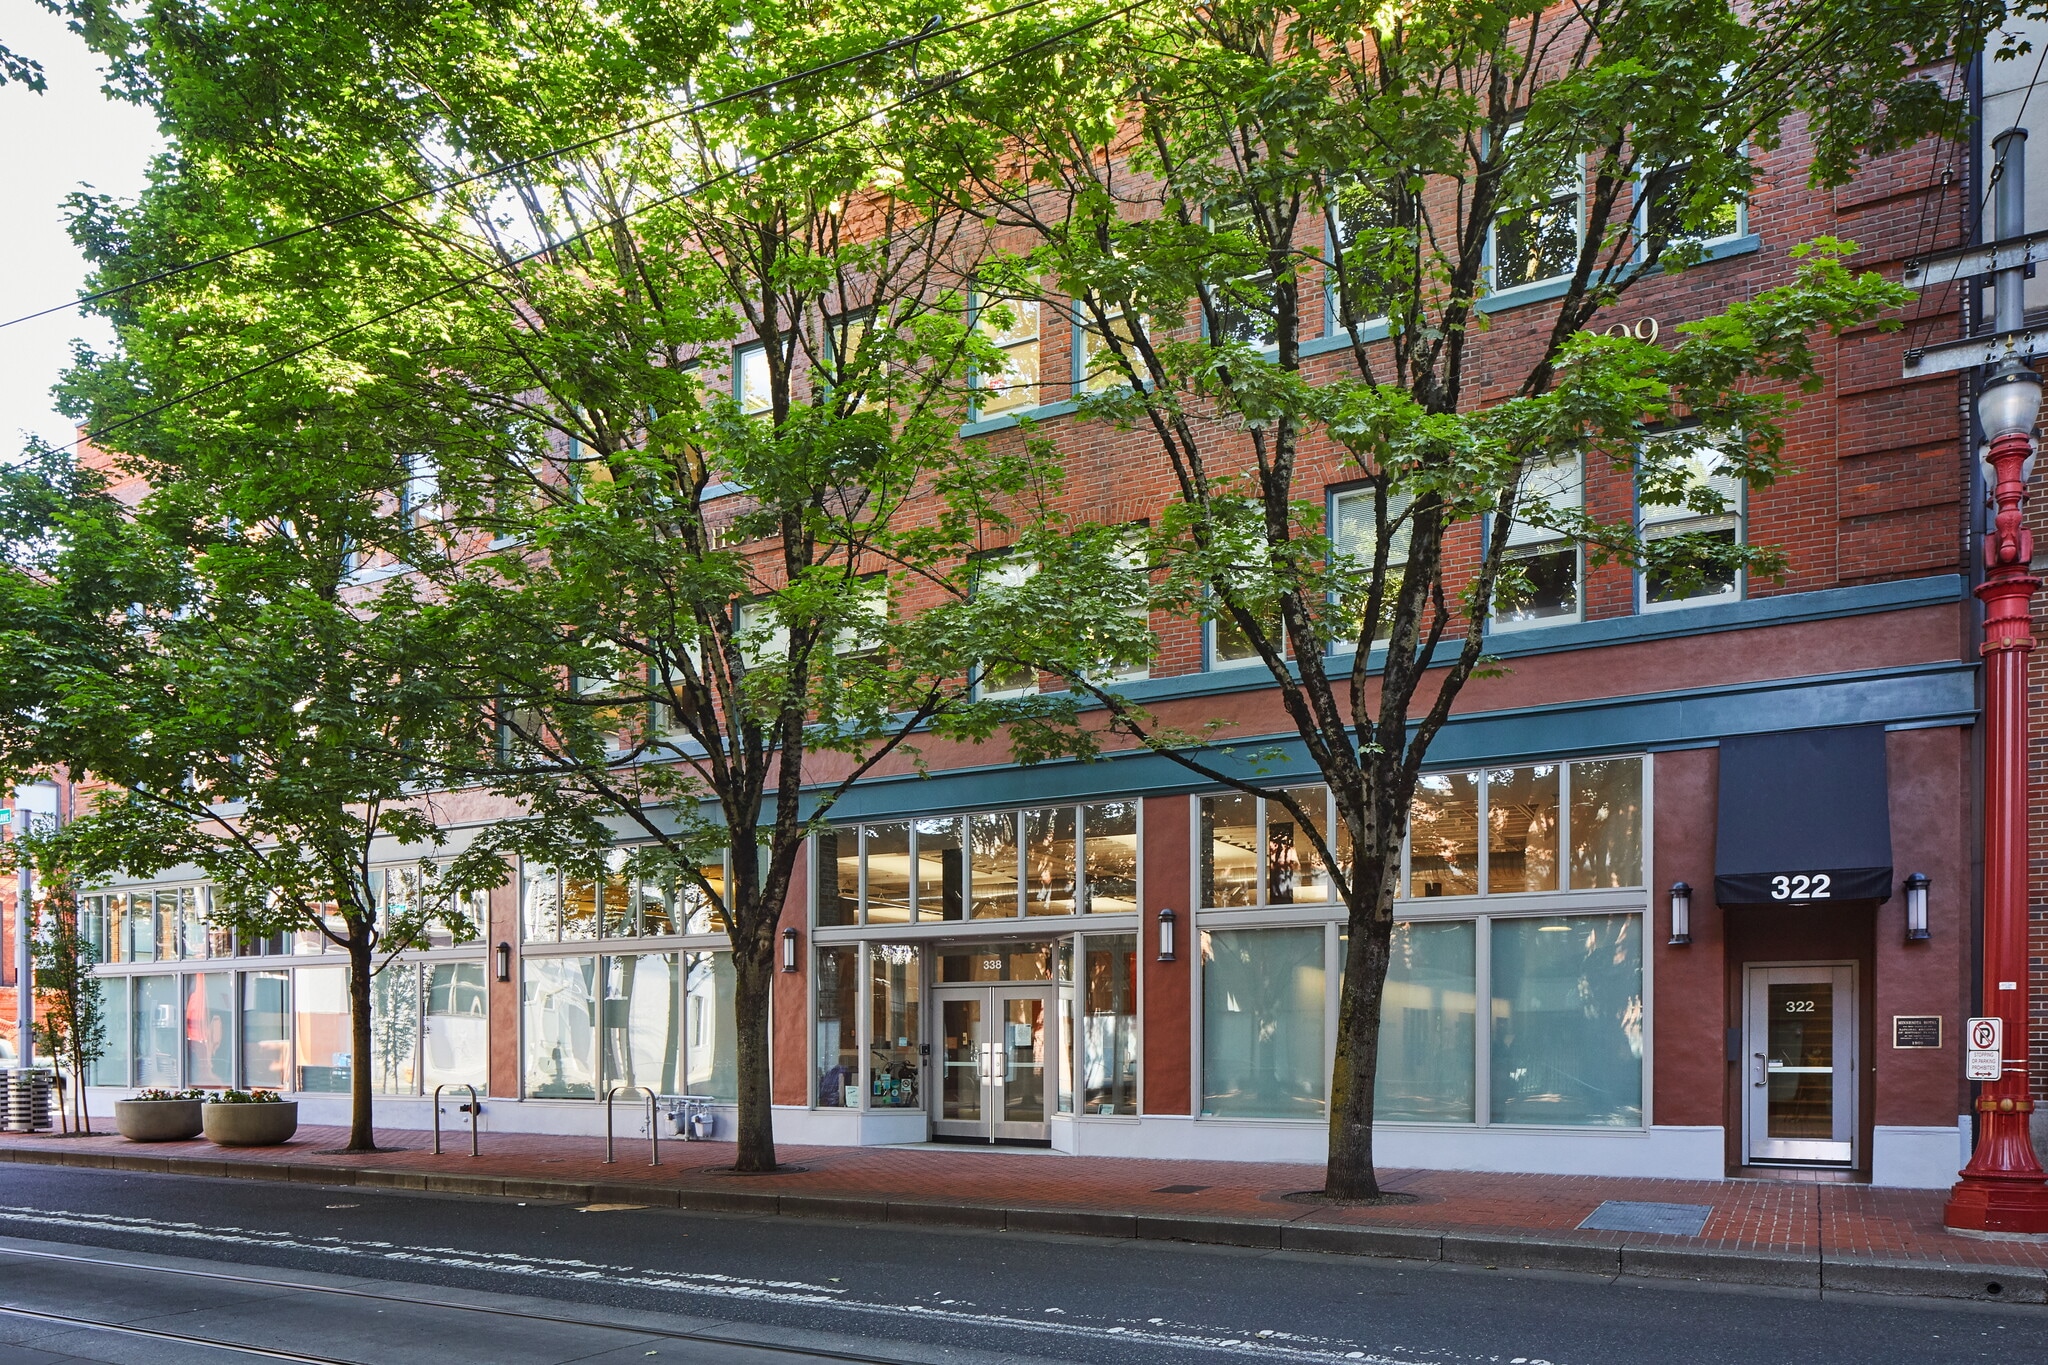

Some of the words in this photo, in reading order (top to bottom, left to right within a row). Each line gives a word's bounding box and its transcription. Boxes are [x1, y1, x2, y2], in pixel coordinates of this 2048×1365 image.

[1771, 873, 1831, 900] 322
[983, 960, 1002, 970] 338
[1785, 1000, 1815, 1013] 322
